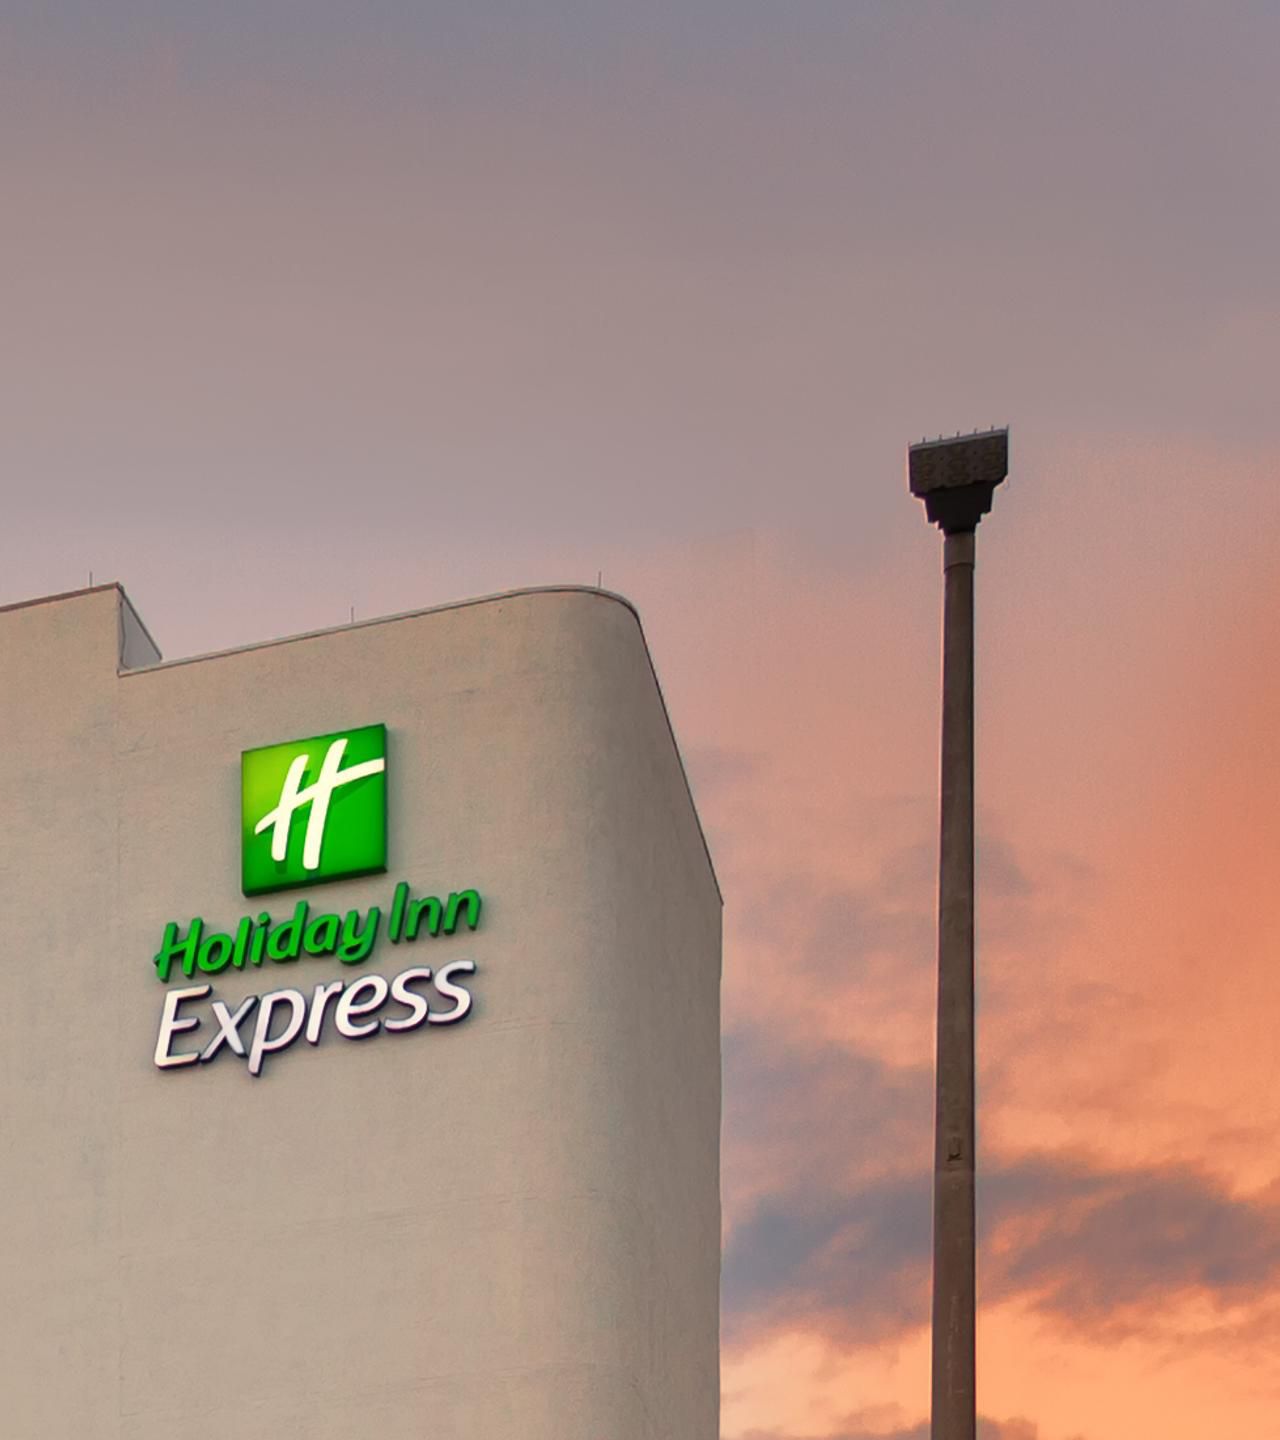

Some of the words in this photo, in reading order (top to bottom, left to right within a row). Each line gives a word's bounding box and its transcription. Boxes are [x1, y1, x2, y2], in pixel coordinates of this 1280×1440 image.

[254, 738, 385, 870] H
[154, 900, 381, 982] Holiday
[388, 881, 481, 943] Inn
[153, 960, 476, 1076] Express
